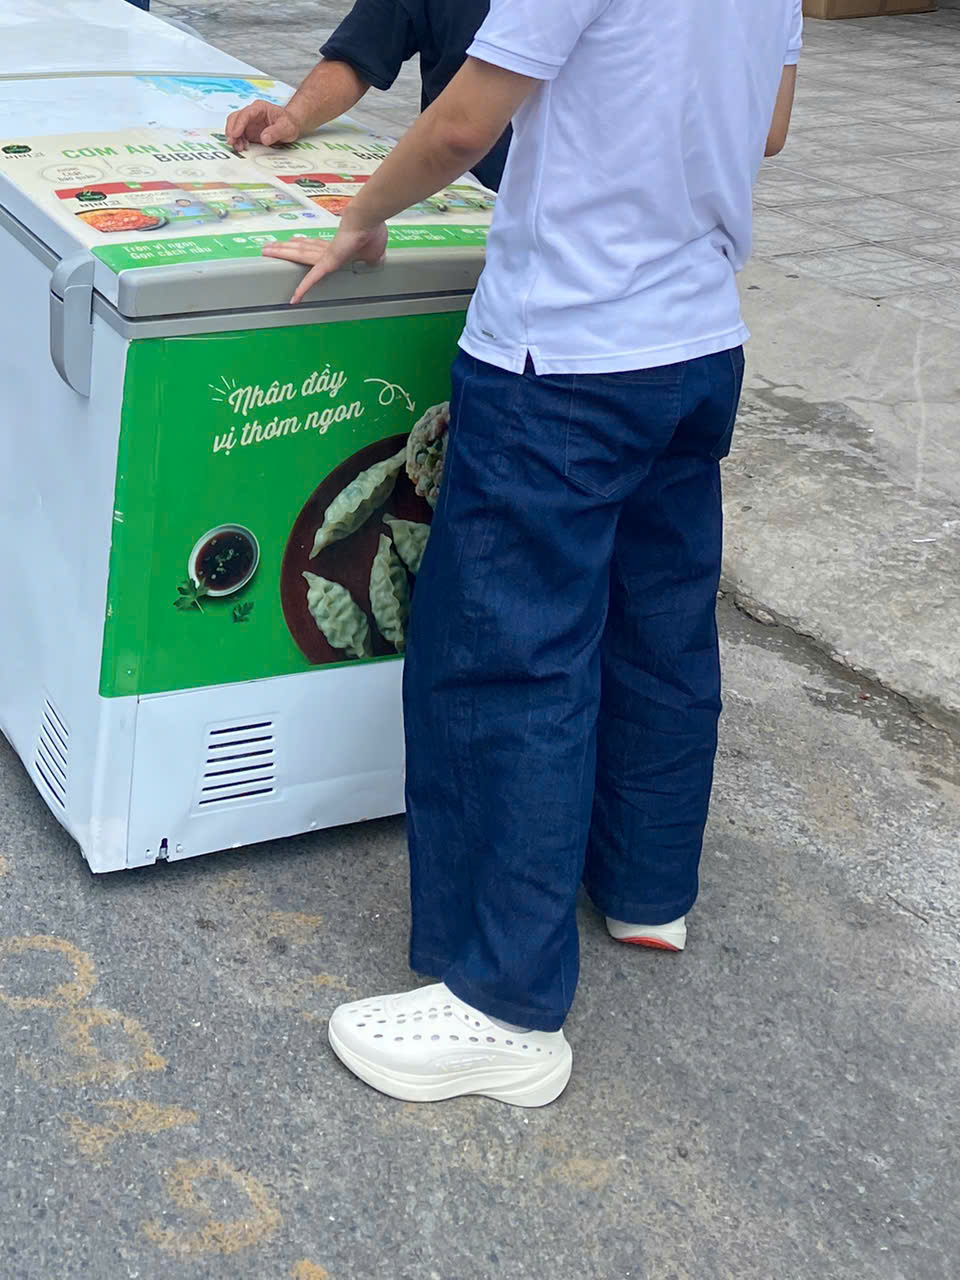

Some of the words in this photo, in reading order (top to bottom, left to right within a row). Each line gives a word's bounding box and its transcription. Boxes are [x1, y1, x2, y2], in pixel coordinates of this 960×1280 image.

[152, 150, 231, 163] BIBIGO
[228, 380, 297, 417] Nhân
[301, 363, 347, 398] đầy
[213, 426, 237, 456] vị
[240, 416, 302, 446] thơm
[304, 400, 365, 435] ngon
